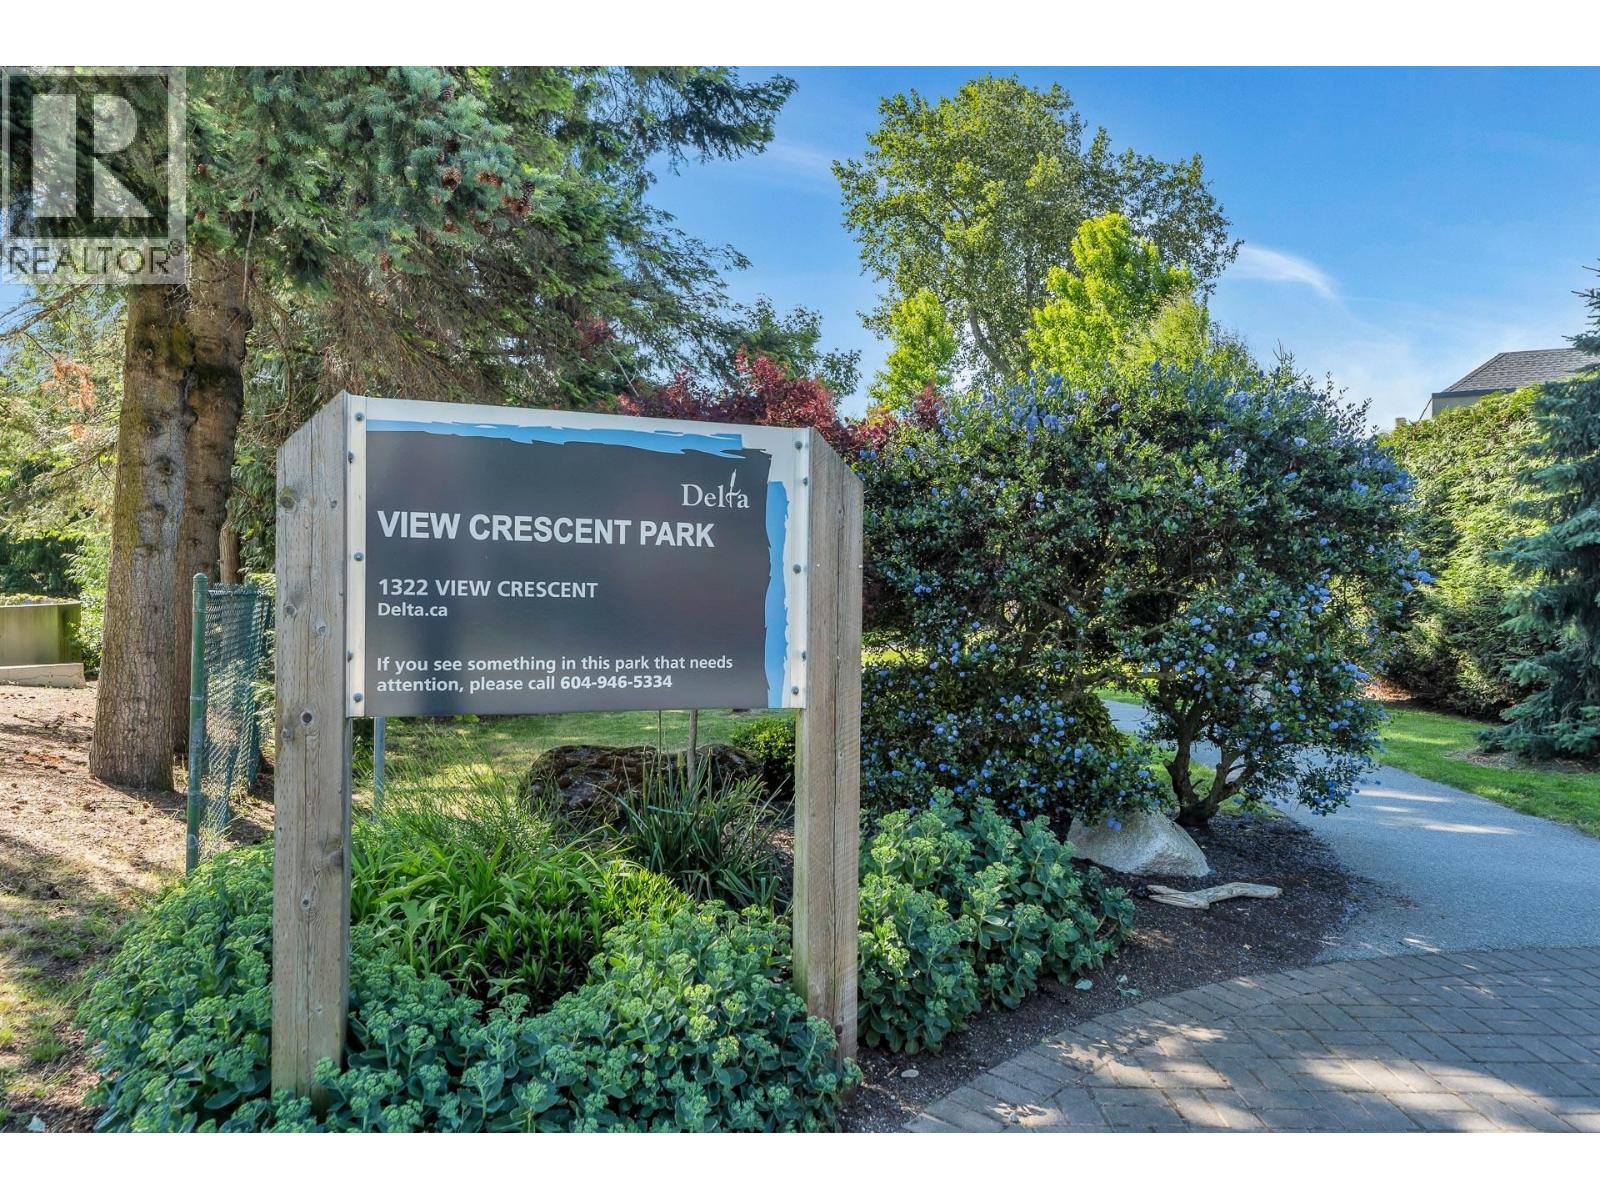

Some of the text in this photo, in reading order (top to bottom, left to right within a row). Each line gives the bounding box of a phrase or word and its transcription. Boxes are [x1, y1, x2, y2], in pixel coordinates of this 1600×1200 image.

[680, 468, 751, 509] Delta
[376, 510, 716, 548] VIEW CRESCENT PARK
[378, 578, 599, 599] 1322 VIEW CRESCENT
[377, 601, 448, 617] Delta.ca
[377, 655, 733, 676] If you see something in this park that needs
[376, 674, 673, 694] attention, please call 604-946-5334
